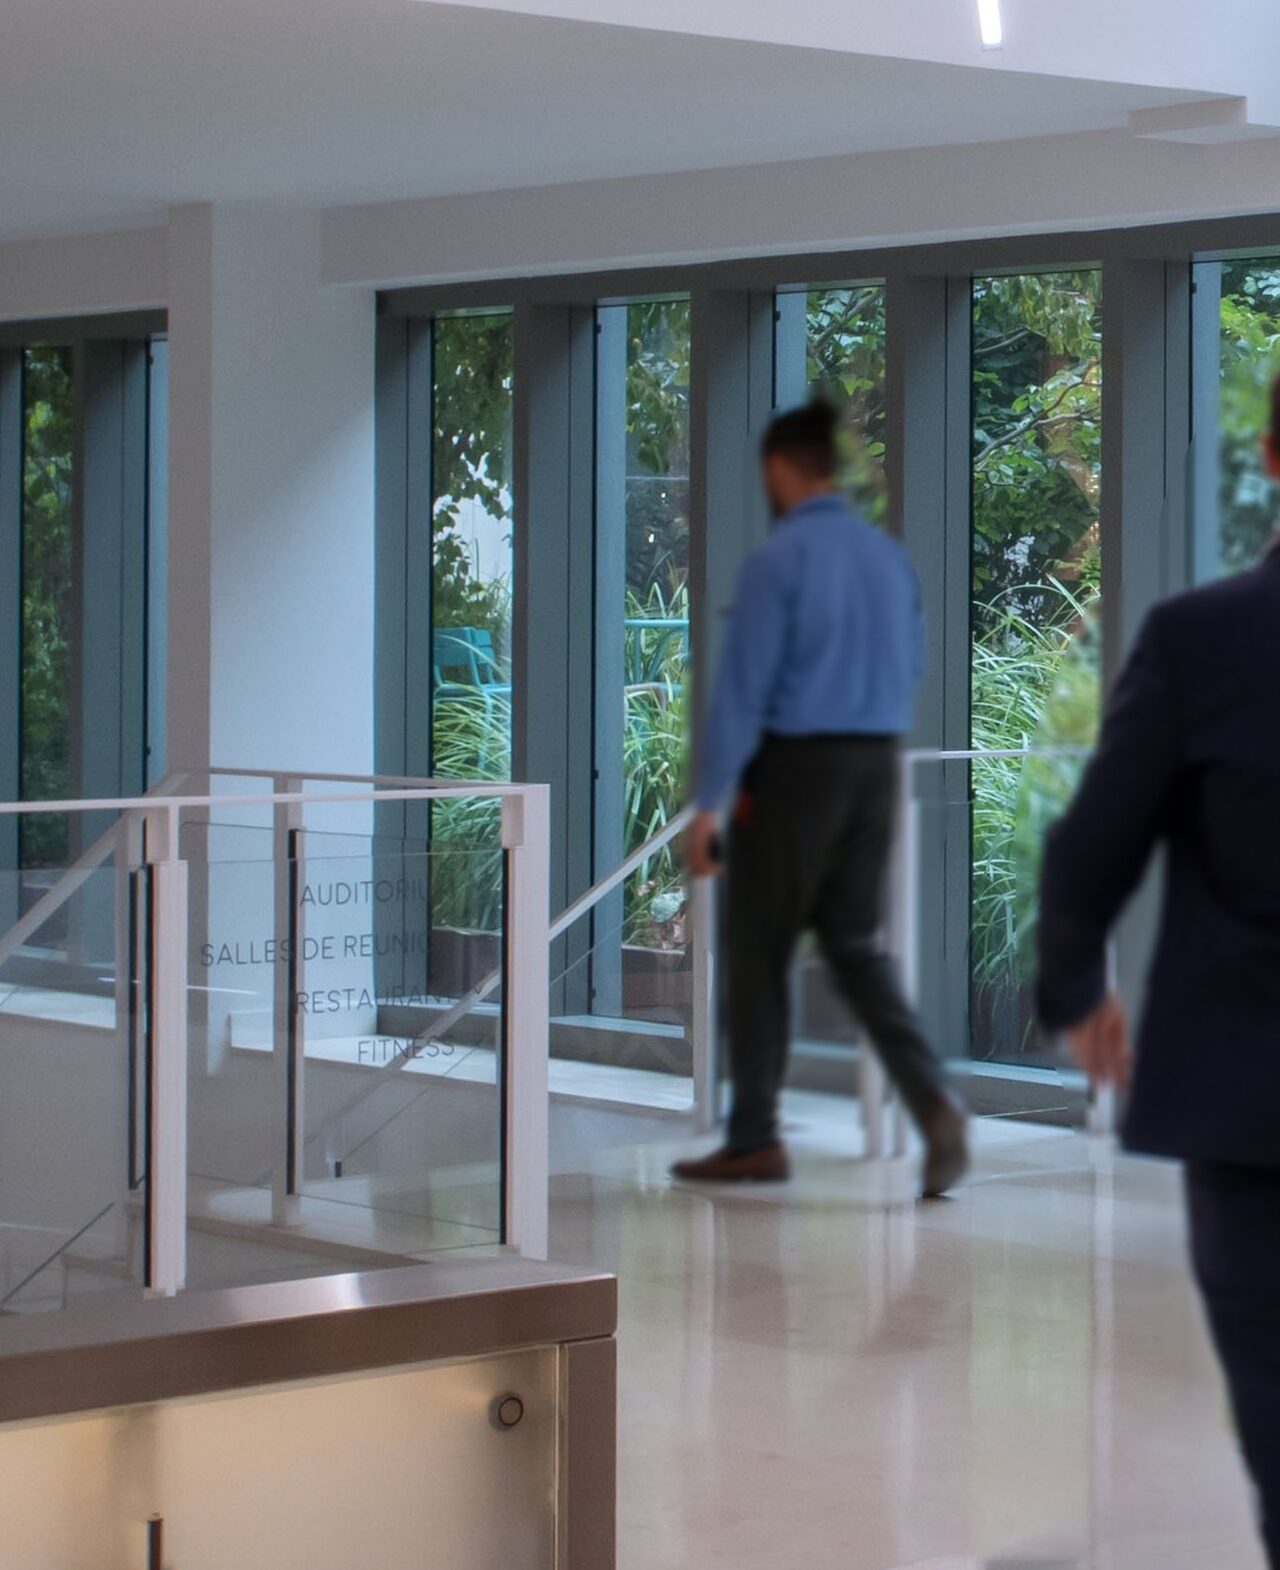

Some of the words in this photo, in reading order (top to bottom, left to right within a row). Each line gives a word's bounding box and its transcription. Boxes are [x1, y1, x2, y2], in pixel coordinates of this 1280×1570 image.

[300, 878, 431, 907] AUDITORIU
[201, 937, 291, 967] SALLES
[302, 936, 335, 961] DE
[344, 931, 430, 959] REUNIO
[358, 1035, 455, 1063] FITNESS
